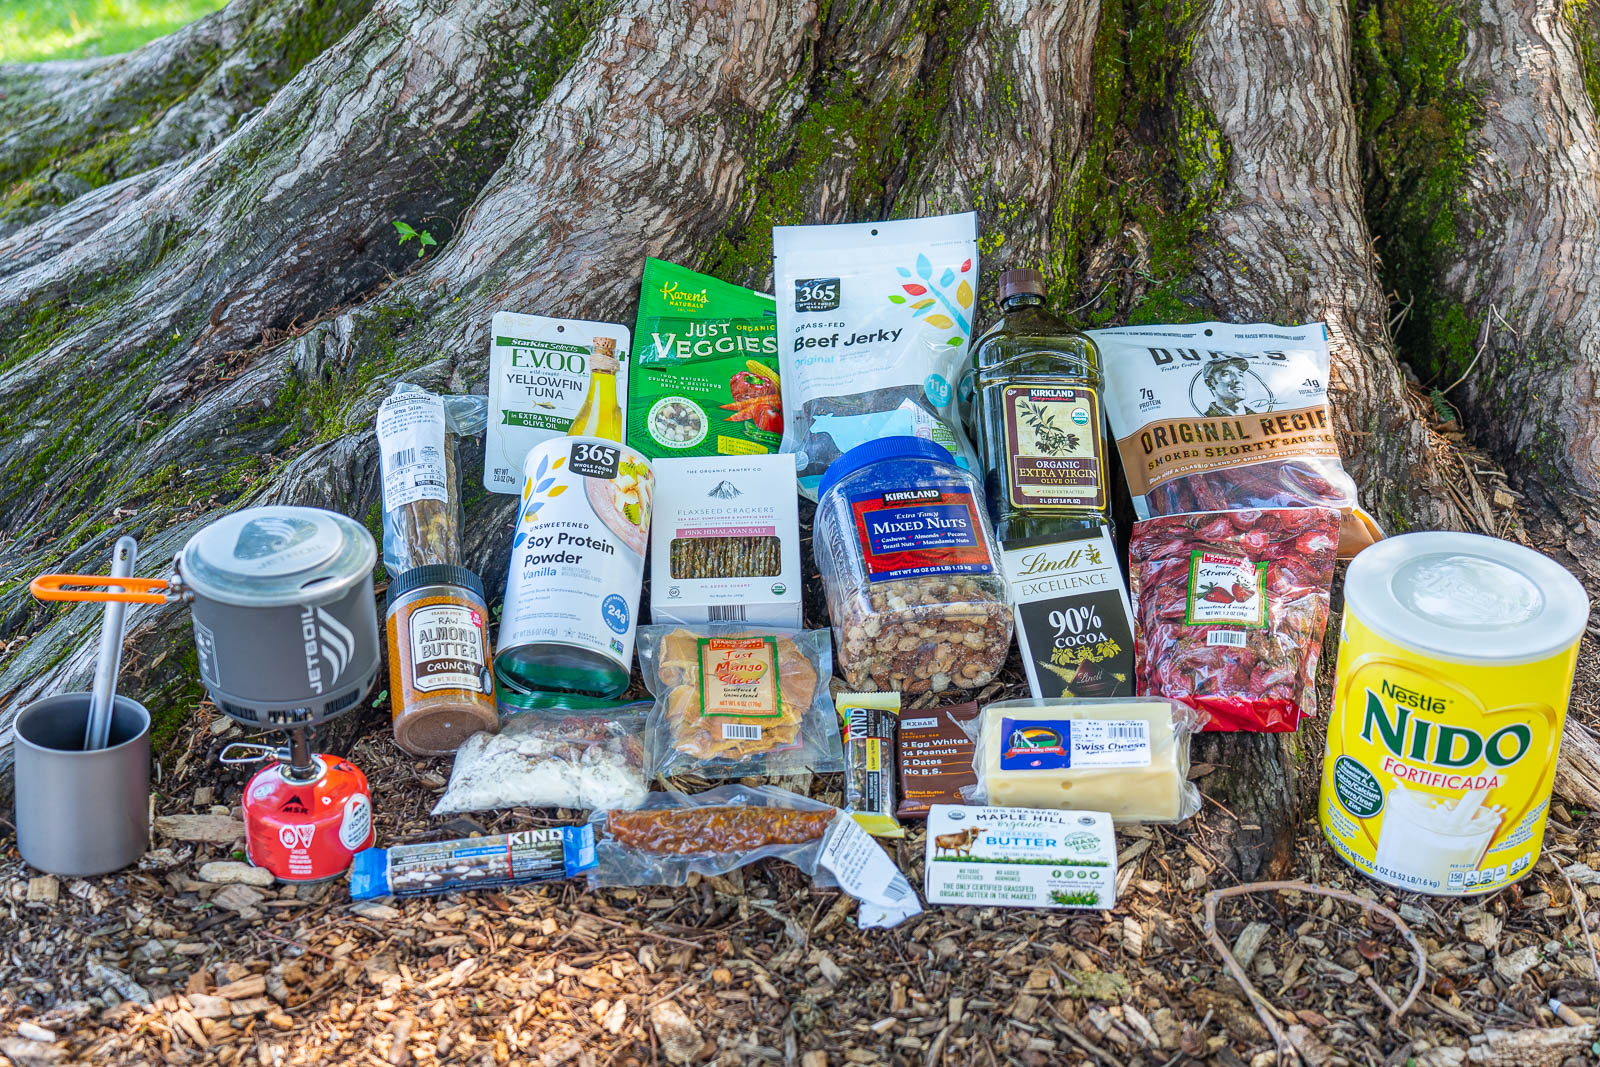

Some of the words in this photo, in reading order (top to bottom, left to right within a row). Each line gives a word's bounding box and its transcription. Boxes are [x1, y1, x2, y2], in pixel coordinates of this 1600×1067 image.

[660, 282, 709, 303] Karen's
[800, 284, 836, 302] 365
[686, 322, 730, 337] JUST
[736, 324, 775, 332] ORGANIC
[796, 322, 845, 333] GRASS-FED
[512, 338, 549, 348] StarKist
[550, 344, 578, 352] Selects
[794, 334, 839, 352] Beef
[844, 328, 903, 346] Jerky
[507, 374, 582, 391] YELLOWFIN
[929, 377, 948, 397] 11g
[1302, 379, 1319, 387] <1g
[525, 387, 564, 400] TUNA
[1140, 388, 1154, 400] 7g
[1139, 400, 1161, 409] PROTEIN
[519, 413, 543, 421] EXTRA
[544, 416, 569, 425] VIRGIN
[523, 420, 544, 428] OLIVE
[1141, 421, 1250, 455] ORIGINAL
[575, 445, 615, 465] 365
[1148, 450, 1199, 470] SMOKED
[1205, 439, 1276, 458] SHORTY
[594, 465, 612, 473] FOODS
[1036, 460, 1080, 469] ORGANIC
[1181, 463, 1208, 472] CLASSIC
[1019, 468, 1056, 477] EXTRA
[1058, 469, 1097, 478] VIRGIN
[885, 490, 939, 501] KIRKLAND
[678, 507, 722, 515] FLAXSEED
[530, 522, 589, 532] UNSWEETENED
[873, 521, 923, 535] MIXED
[927, 518, 967, 529] NUTS
[527, 536, 553, 549] Soy
[558, 532, 615, 555] Protein
[881, 535, 906, 543] Cashews
[524, 551, 582, 567] Powder
[1017, 550, 1083, 577] Lindt
[522, 567, 556, 580] Vanilla
[1022, 573, 1109, 596] EXCELLENCE
[608, 604, 625, 624] 24g
[1049, 605, 1101, 638] 90%
[419, 627, 476, 644] ALMOND
[1055, 632, 1108, 648] COCOA
[301, 605, 323, 694] JETBOIL
[422, 642, 477, 660] BUTTER
[722, 651, 753, 660] Just
[427, 661, 475, 673] CRUNCHY
[716, 661, 762, 672] Mango
[720, 673, 760, 685] Slices
[1076, 671, 1102, 683] Lindt
[851, 708, 868, 738] KIND
[1360, 688, 1531, 768] NIDO
[917, 748, 958, 756] Peanuts
[1384, 757, 1498, 790] FORTIFICADA
[1337, 771, 1380, 800] Calcio/Calcium
[1340, 784, 1373, 808] Hierro/Iron
[1348, 800, 1361, 812] Zinc
[997, 820, 1042, 830] organic
[1033, 815, 1065, 824] HILL
[508, 830, 563, 846] KIND
[986, 837, 1057, 847] BUTTER
[1064, 837, 1100, 847] GRASS
[1350, 850, 1365, 864] NETO
[1366, 860, 1378, 871] 56.4
[1380, 866, 1388, 875] OZ
[1390, 870, 1405, 880] (3.52
[1429, 878, 1440, 888] kg)
